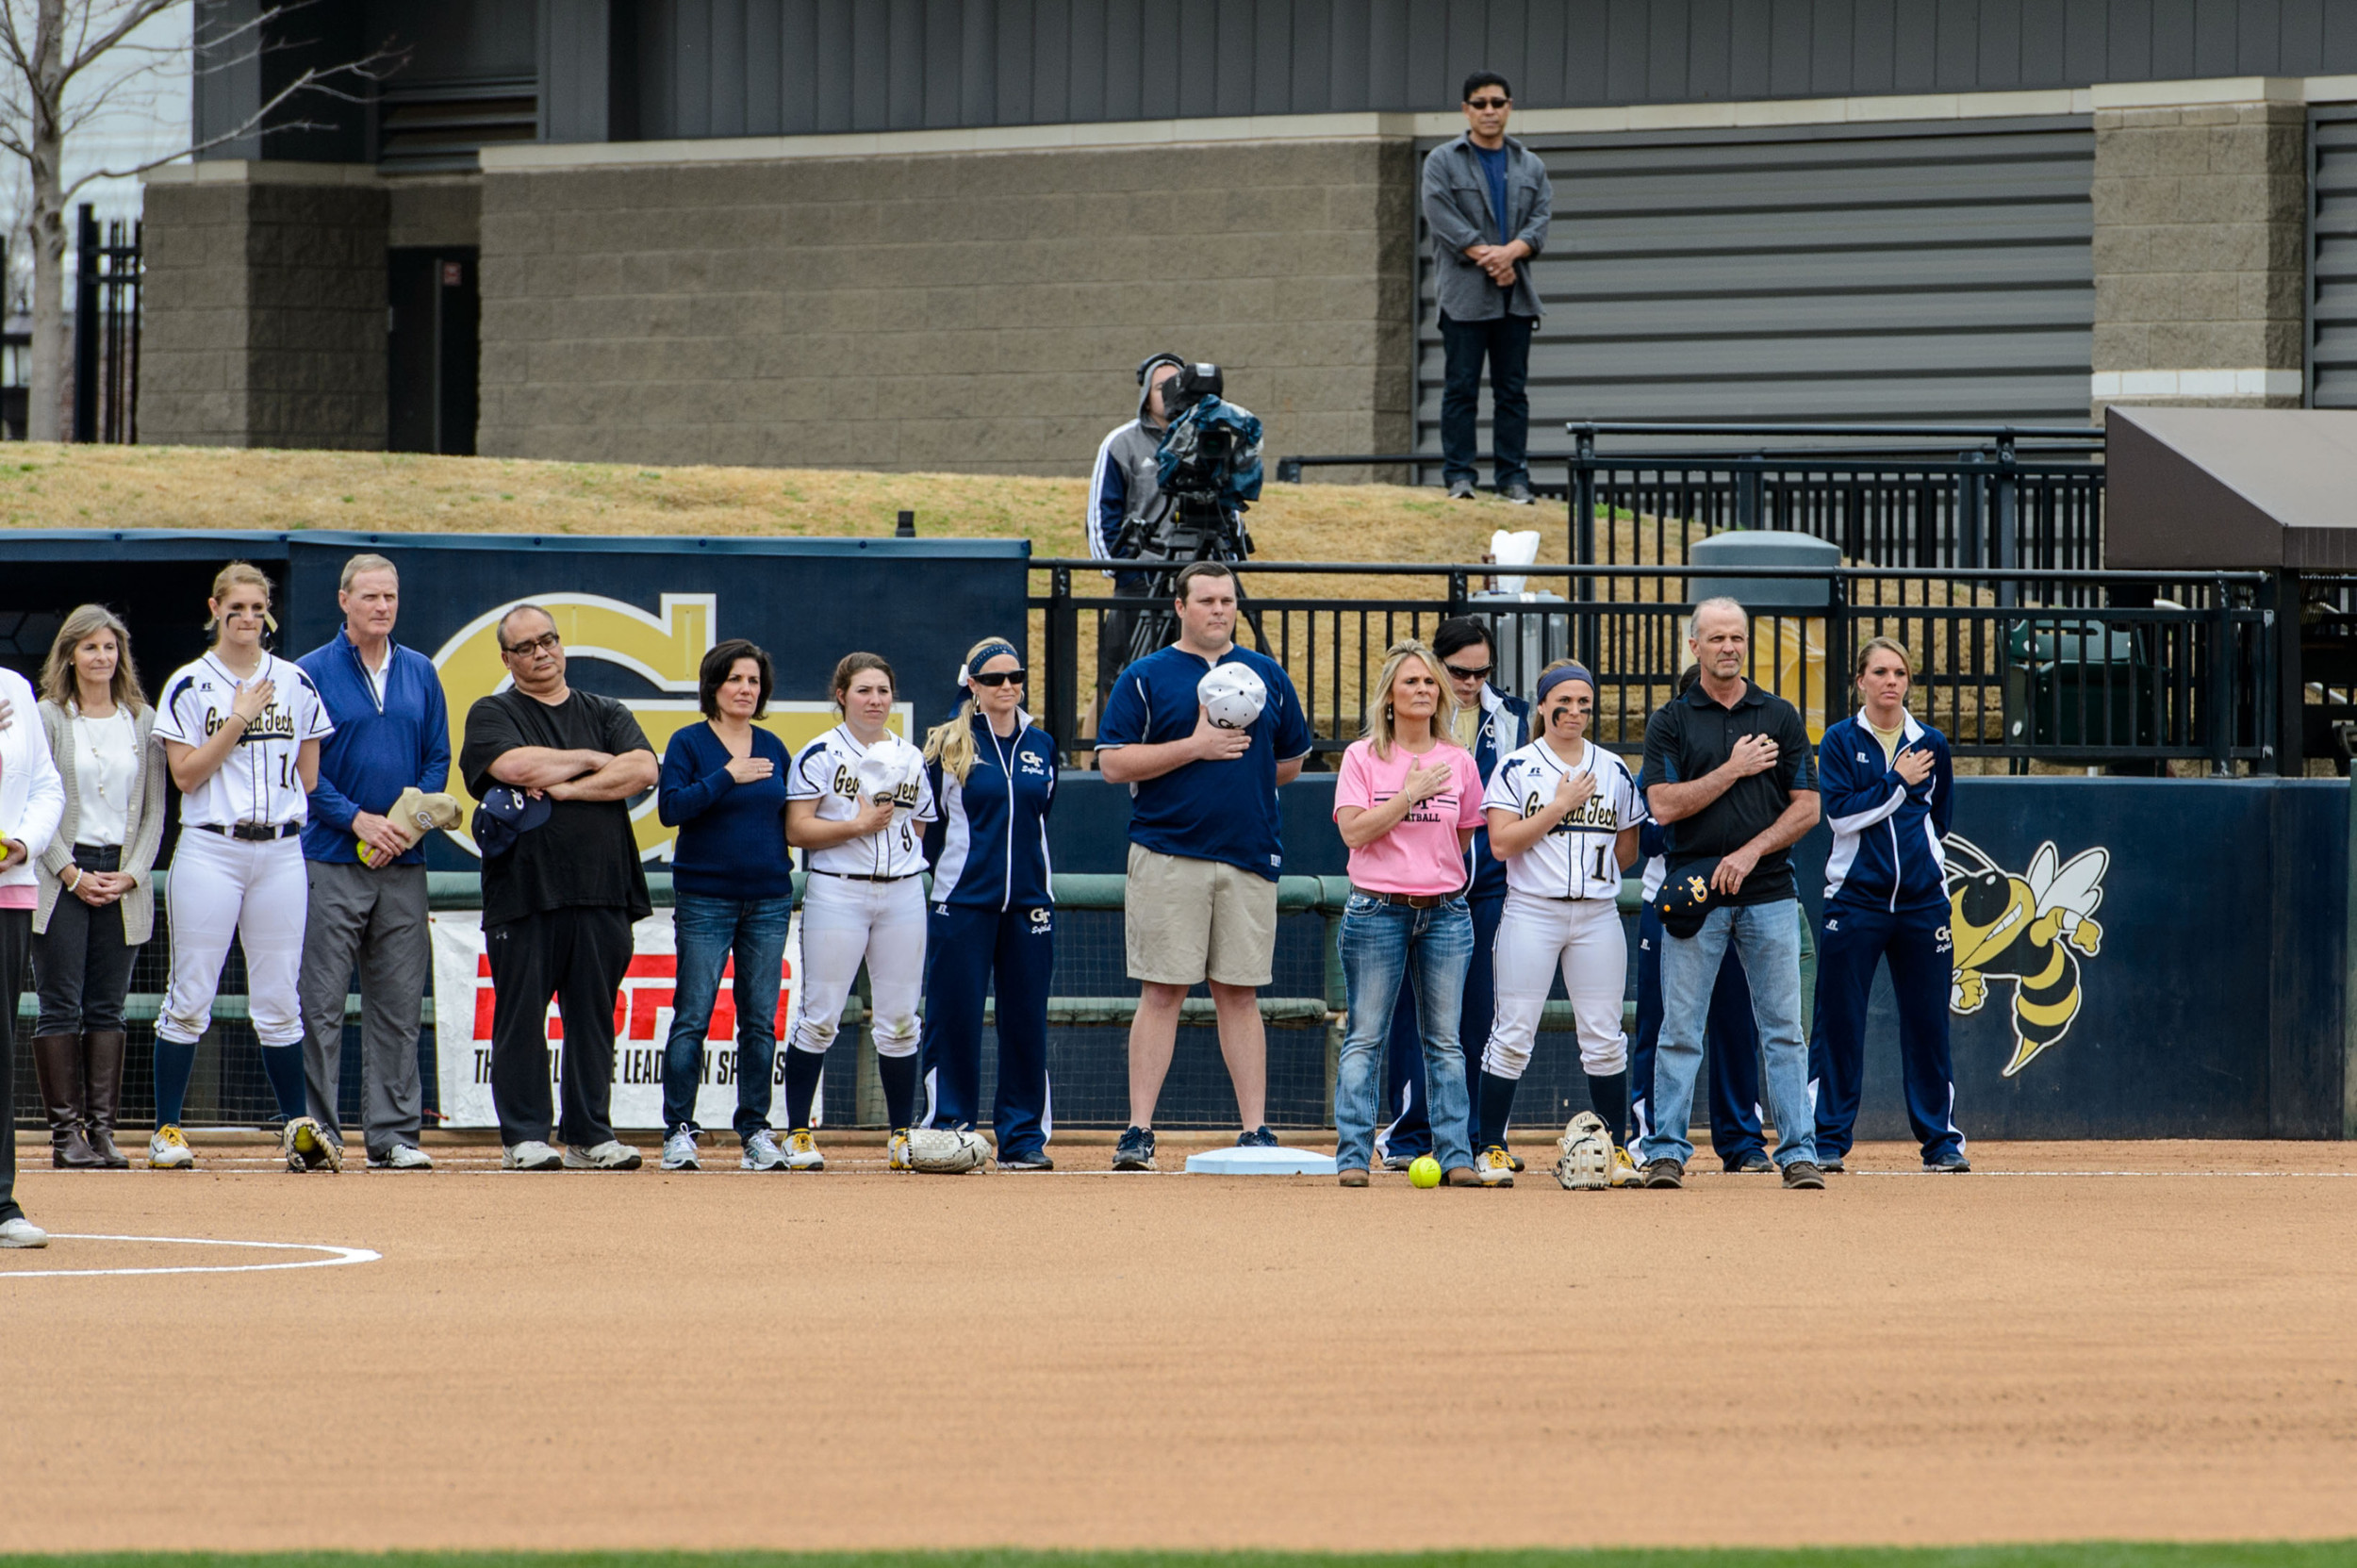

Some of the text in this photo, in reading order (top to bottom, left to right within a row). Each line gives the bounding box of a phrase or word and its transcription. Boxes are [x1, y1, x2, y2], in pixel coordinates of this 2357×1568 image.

[265, 702, 294, 734] Tech
[1020, 751, 1044, 767] GT
[1588, 794, 1618, 828] Tech
[900, 820, 913, 852] 9
[1030, 907, 1051, 924] GT
[623, 1049, 665, 1084] LEAD
[717, 1049, 786, 1085] SPS
